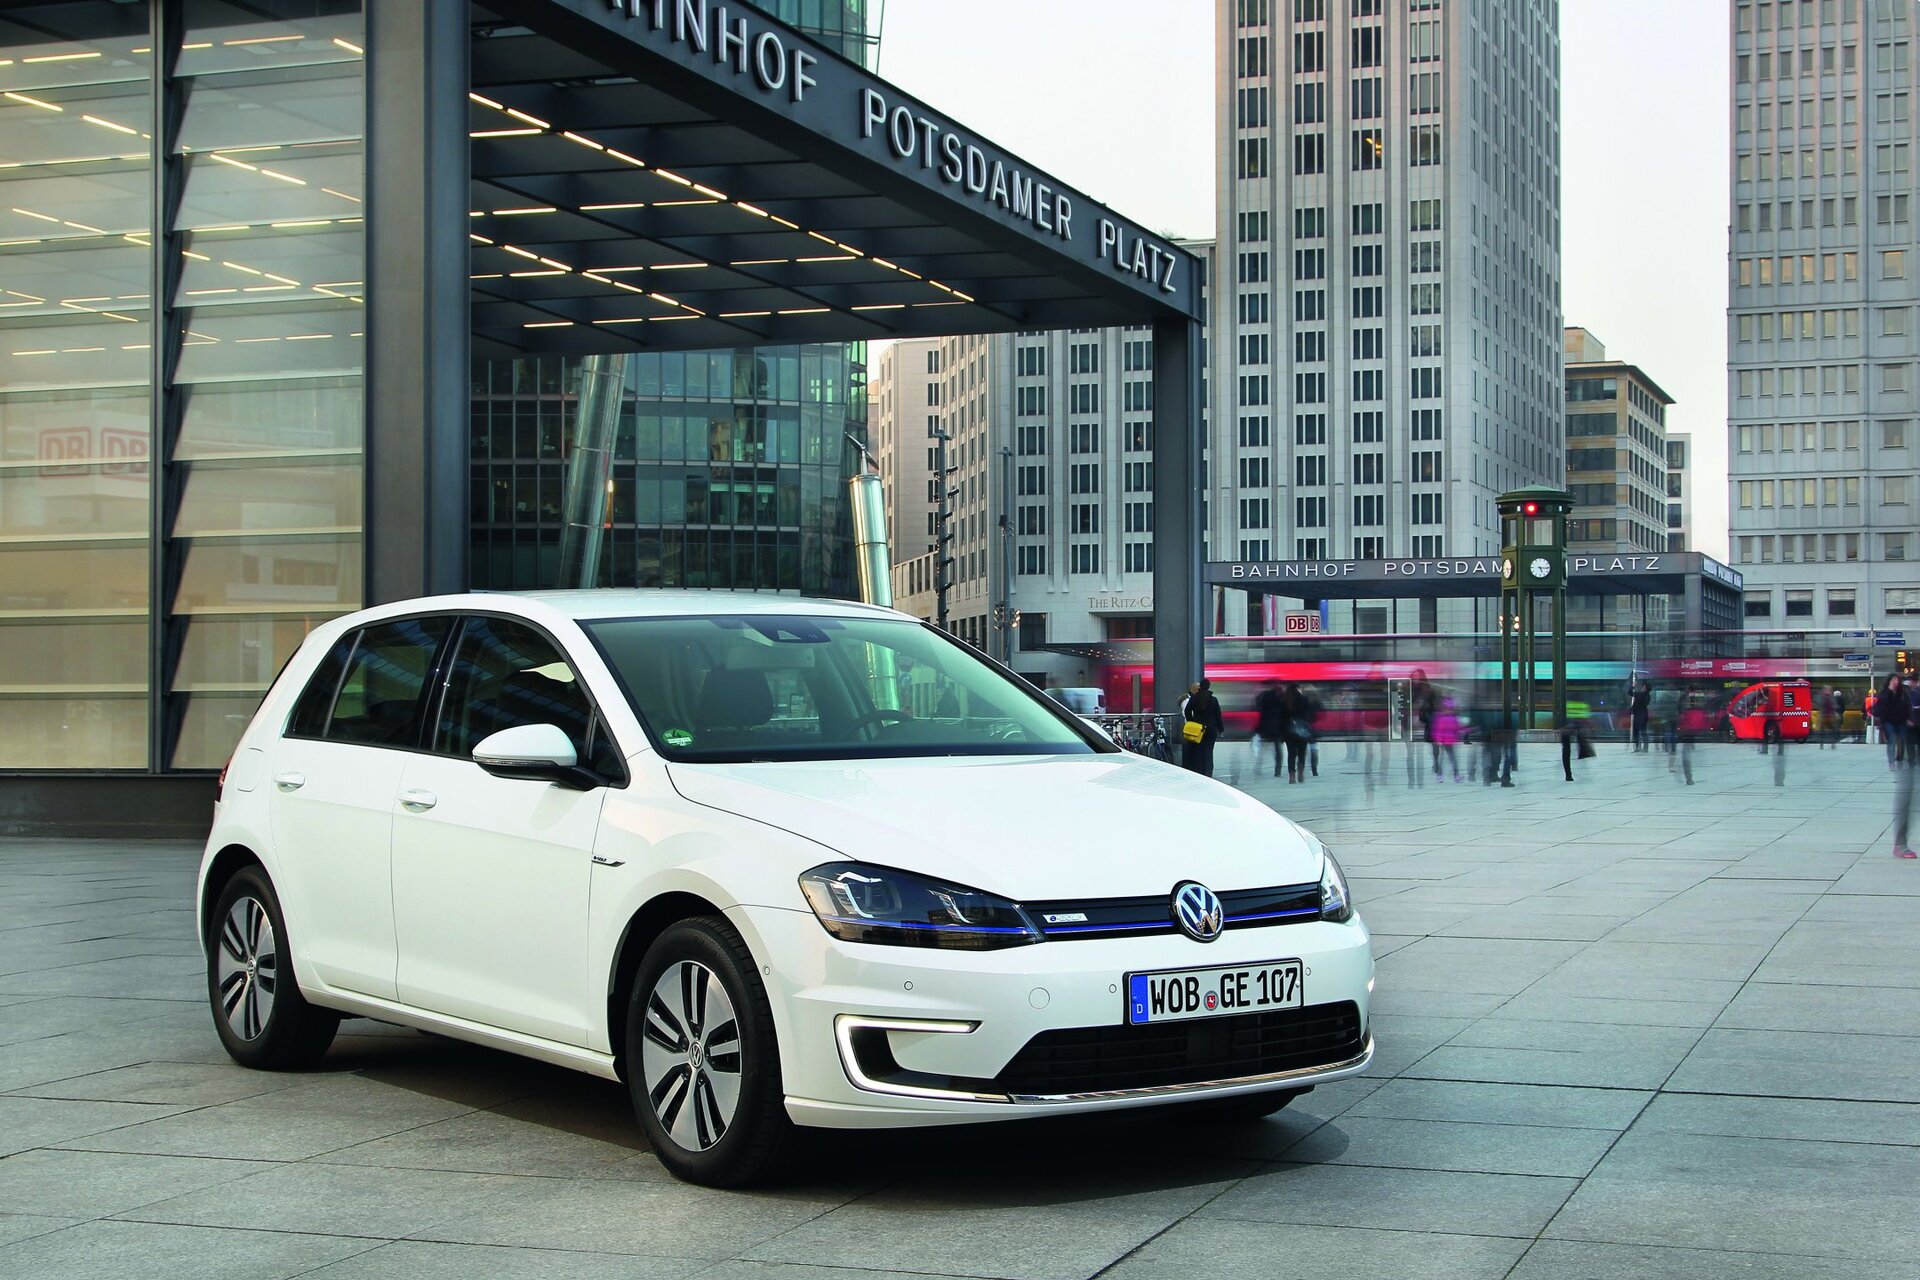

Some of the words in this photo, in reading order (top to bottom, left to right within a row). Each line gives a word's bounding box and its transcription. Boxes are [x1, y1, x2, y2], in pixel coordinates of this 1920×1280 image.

[609, 0, 818, 101] NHOF
[862, 87, 1072, 241] POTSDAMER
[1100, 218, 1177, 293] PLATZ
[1231, 562, 1356, 578] BAHNHOF
[1384, 560, 1502, 575] POTSDAM
[1575, 556, 1660, 571] PLATZ
[1087, 597, 1109, 609] THE
[1288, 618, 1306, 630] DB
[1150, 976, 1201, 1015] WOB
[1219, 971, 1251, 1008] GE
[1256, 967, 1299, 1004] 107
[1136, 1003, 1144, 1014] D
